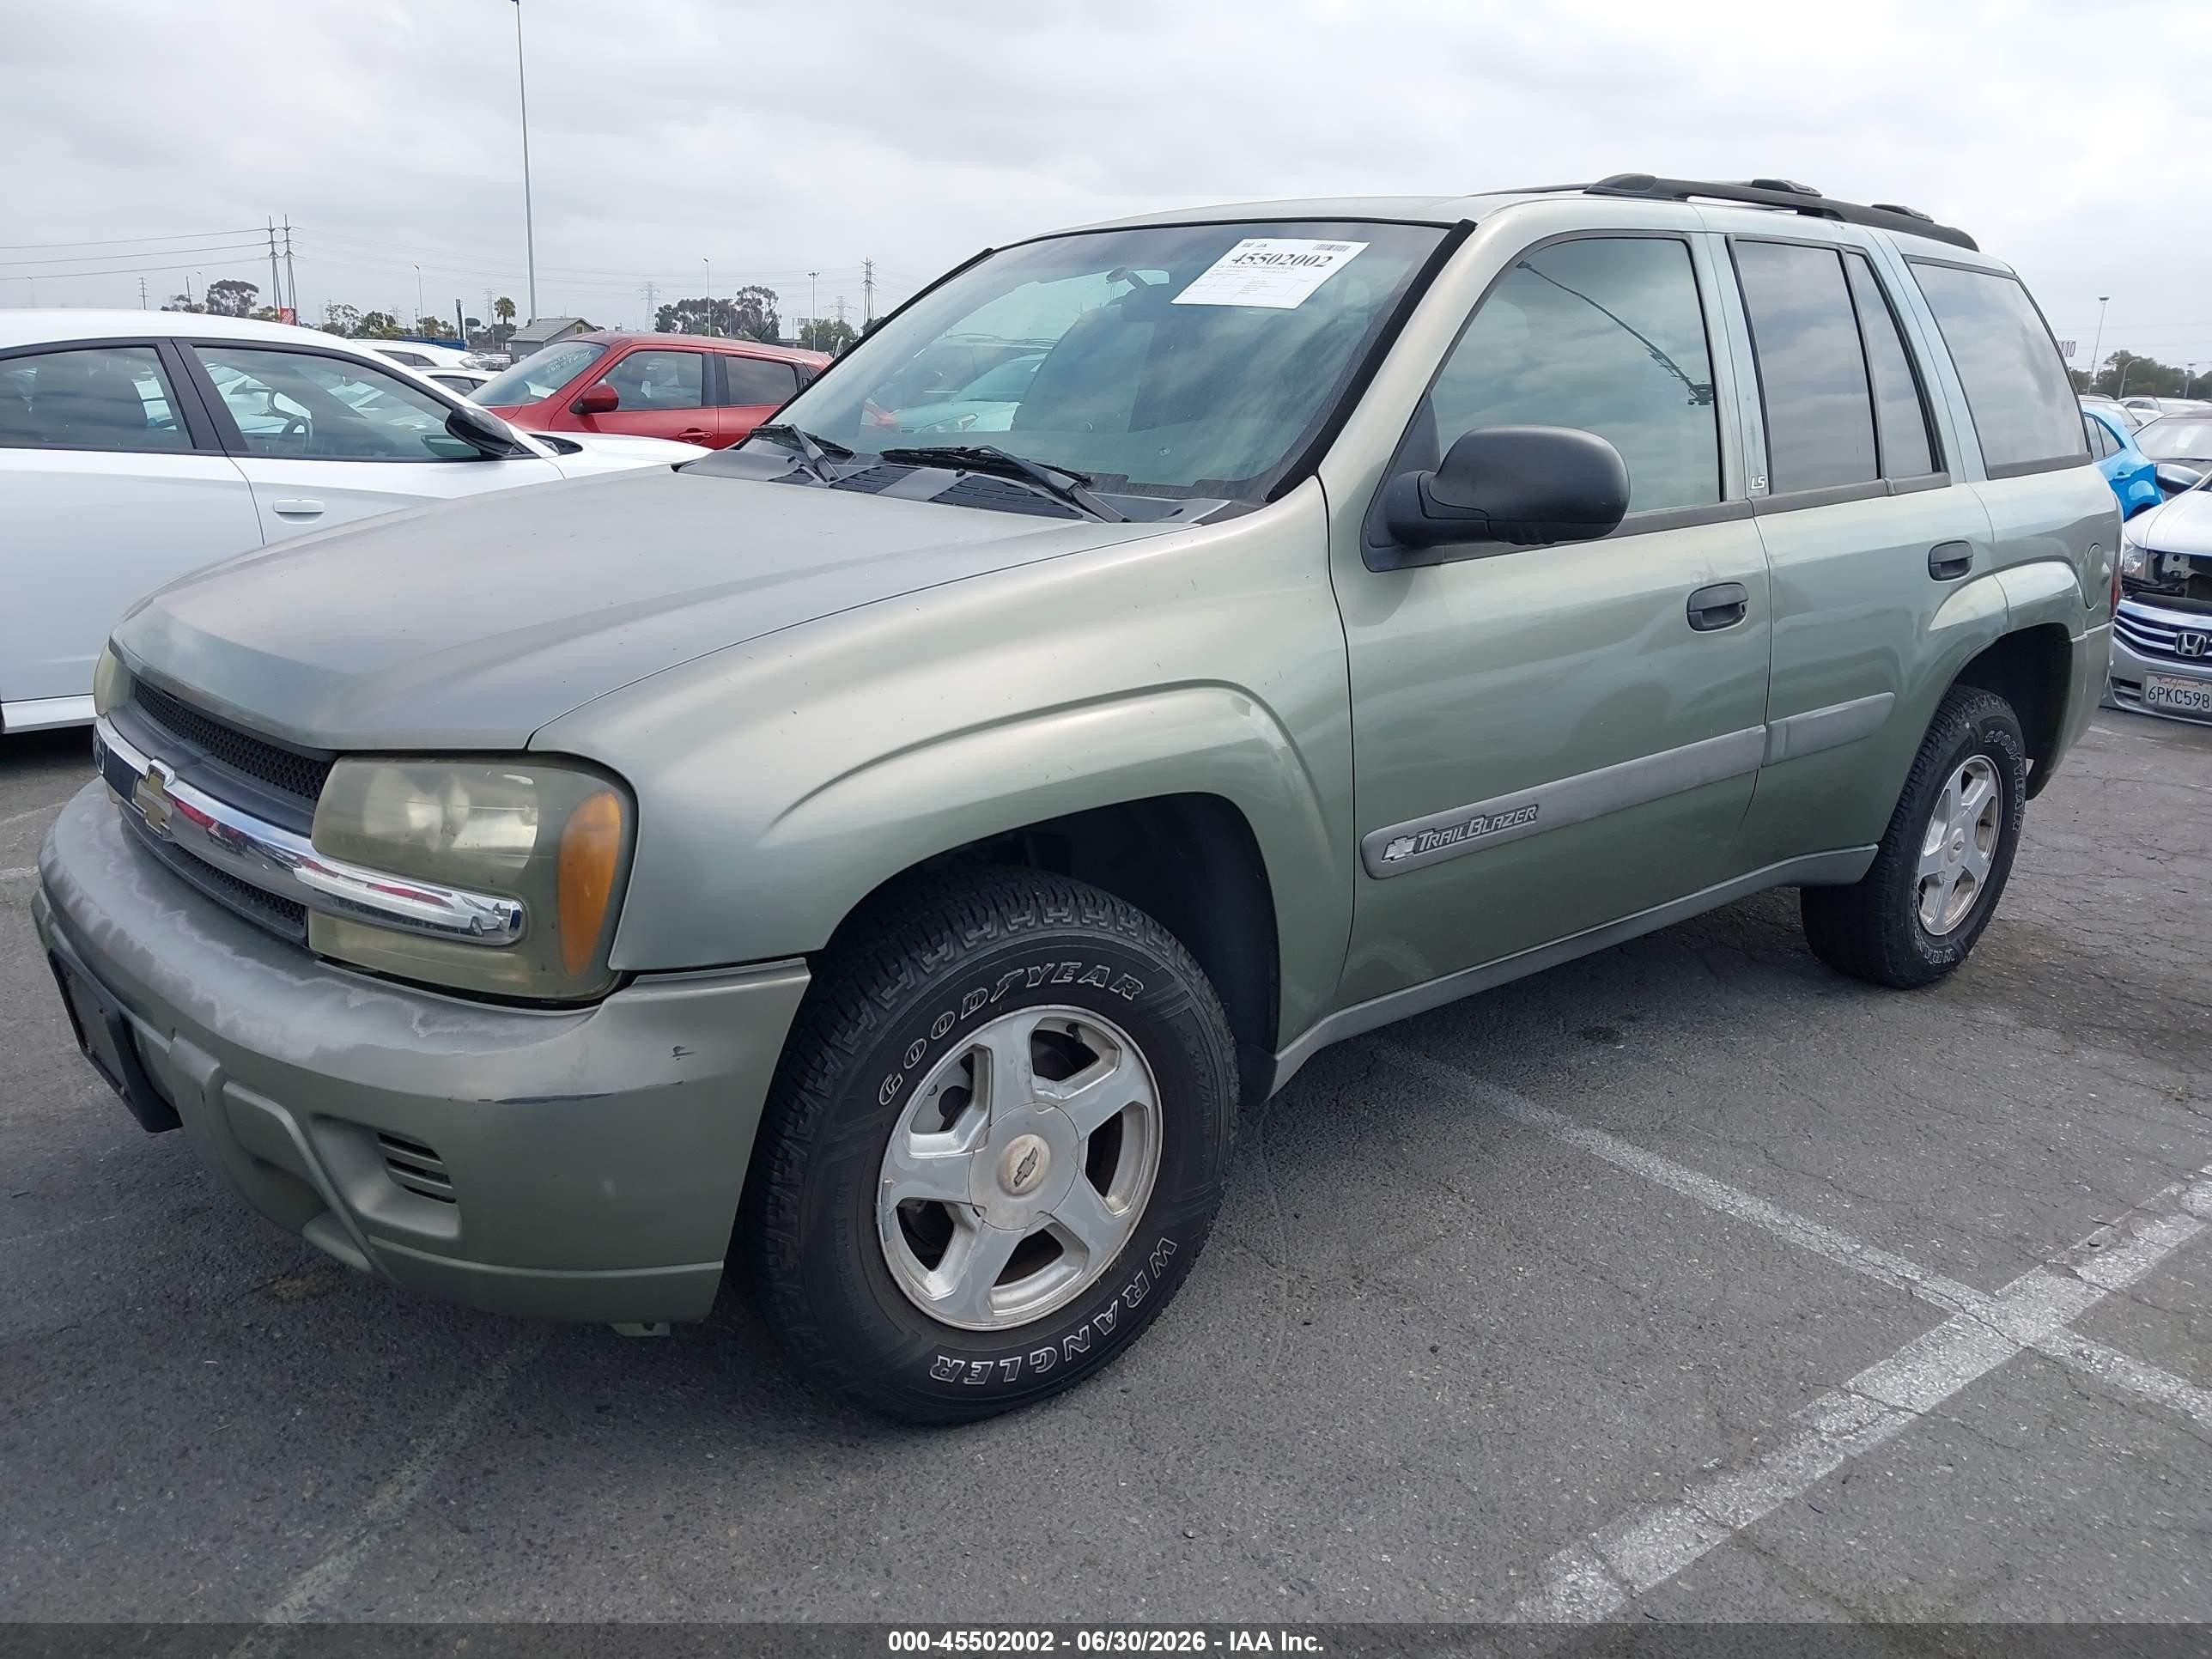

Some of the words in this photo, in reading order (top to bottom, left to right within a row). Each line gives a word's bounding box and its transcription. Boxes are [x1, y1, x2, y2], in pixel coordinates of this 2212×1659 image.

[1231, 252, 1334, 267] 45502002
[1751, 475, 1765, 489] LS
[2148, 686, 2210, 708] 6PKC598
[878, 962, 1145, 1106] GOODYEAR
[929, 1237, 1177, 1385] WRANGLER
